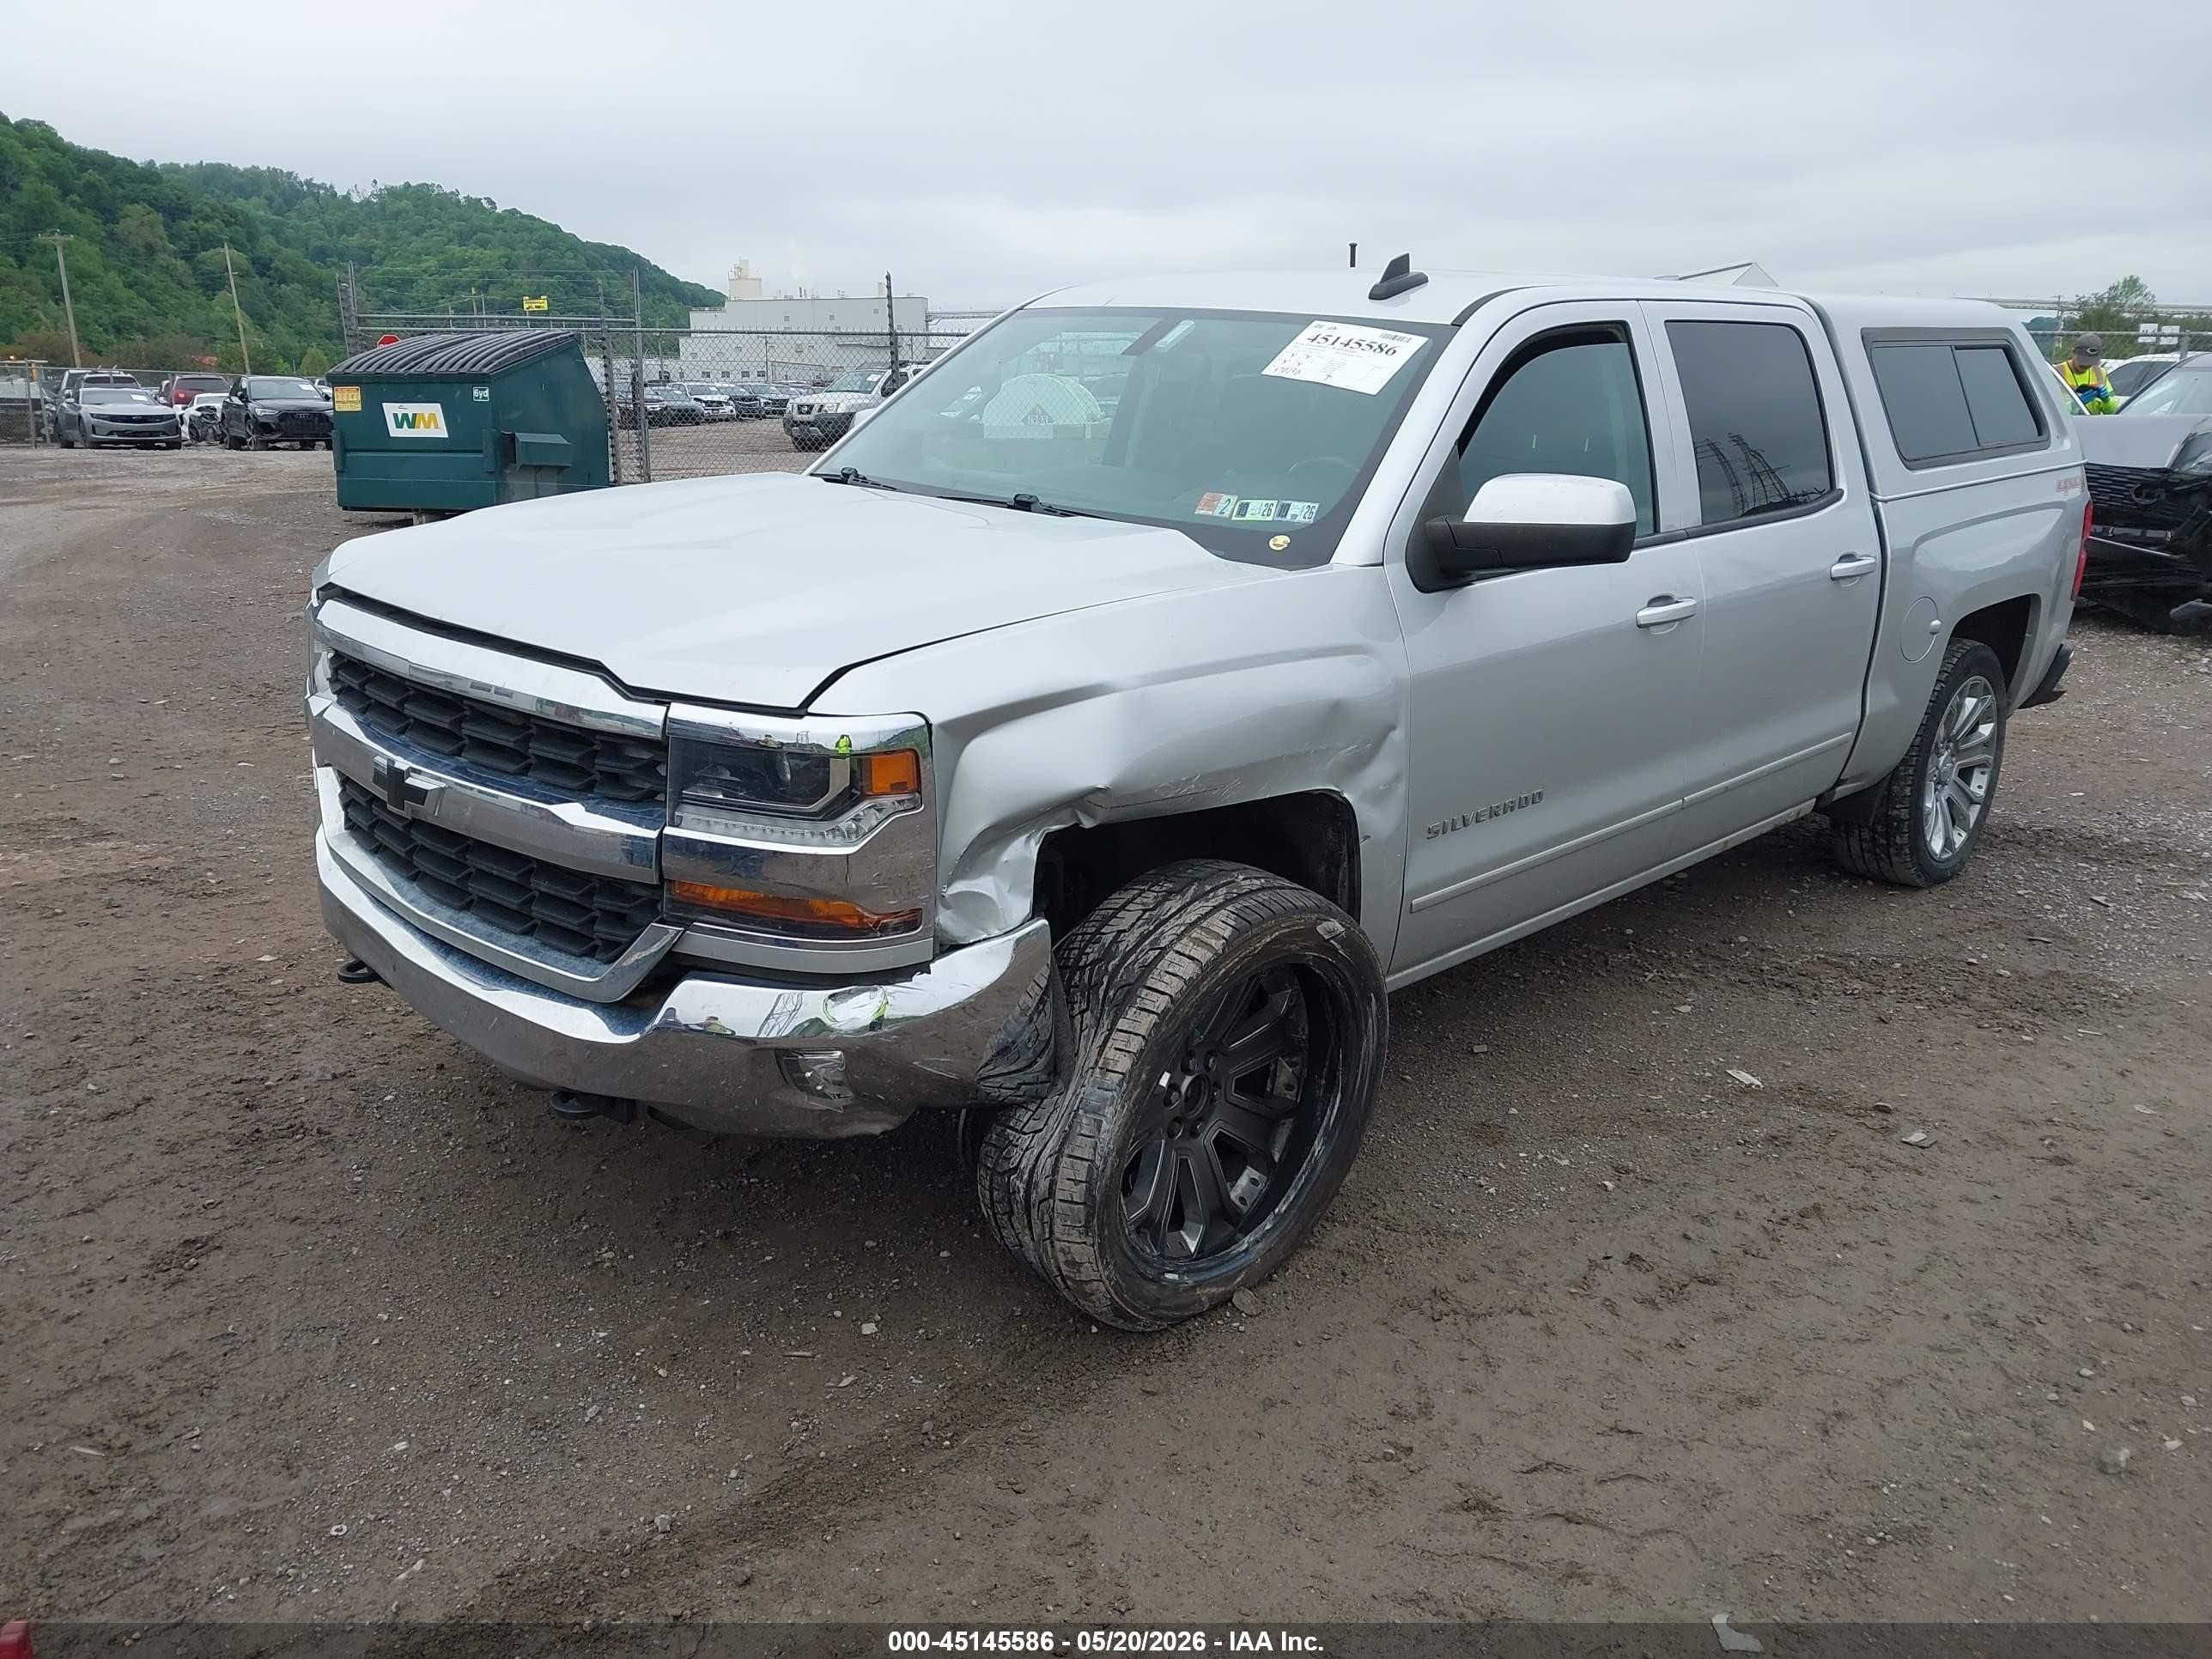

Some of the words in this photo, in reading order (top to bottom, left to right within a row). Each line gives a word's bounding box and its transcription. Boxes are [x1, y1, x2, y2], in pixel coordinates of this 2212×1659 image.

[1307, 332, 1402, 356] 45145586
[474, 389, 489, 399] 6yd
[392, 412, 441, 429] WM
[1218, 498, 1231, 515] 2
[1261, 503, 1274, 517] 26
[1304, 505, 1316, 520] 26
[1426, 788, 1544, 840] SILVERADO
